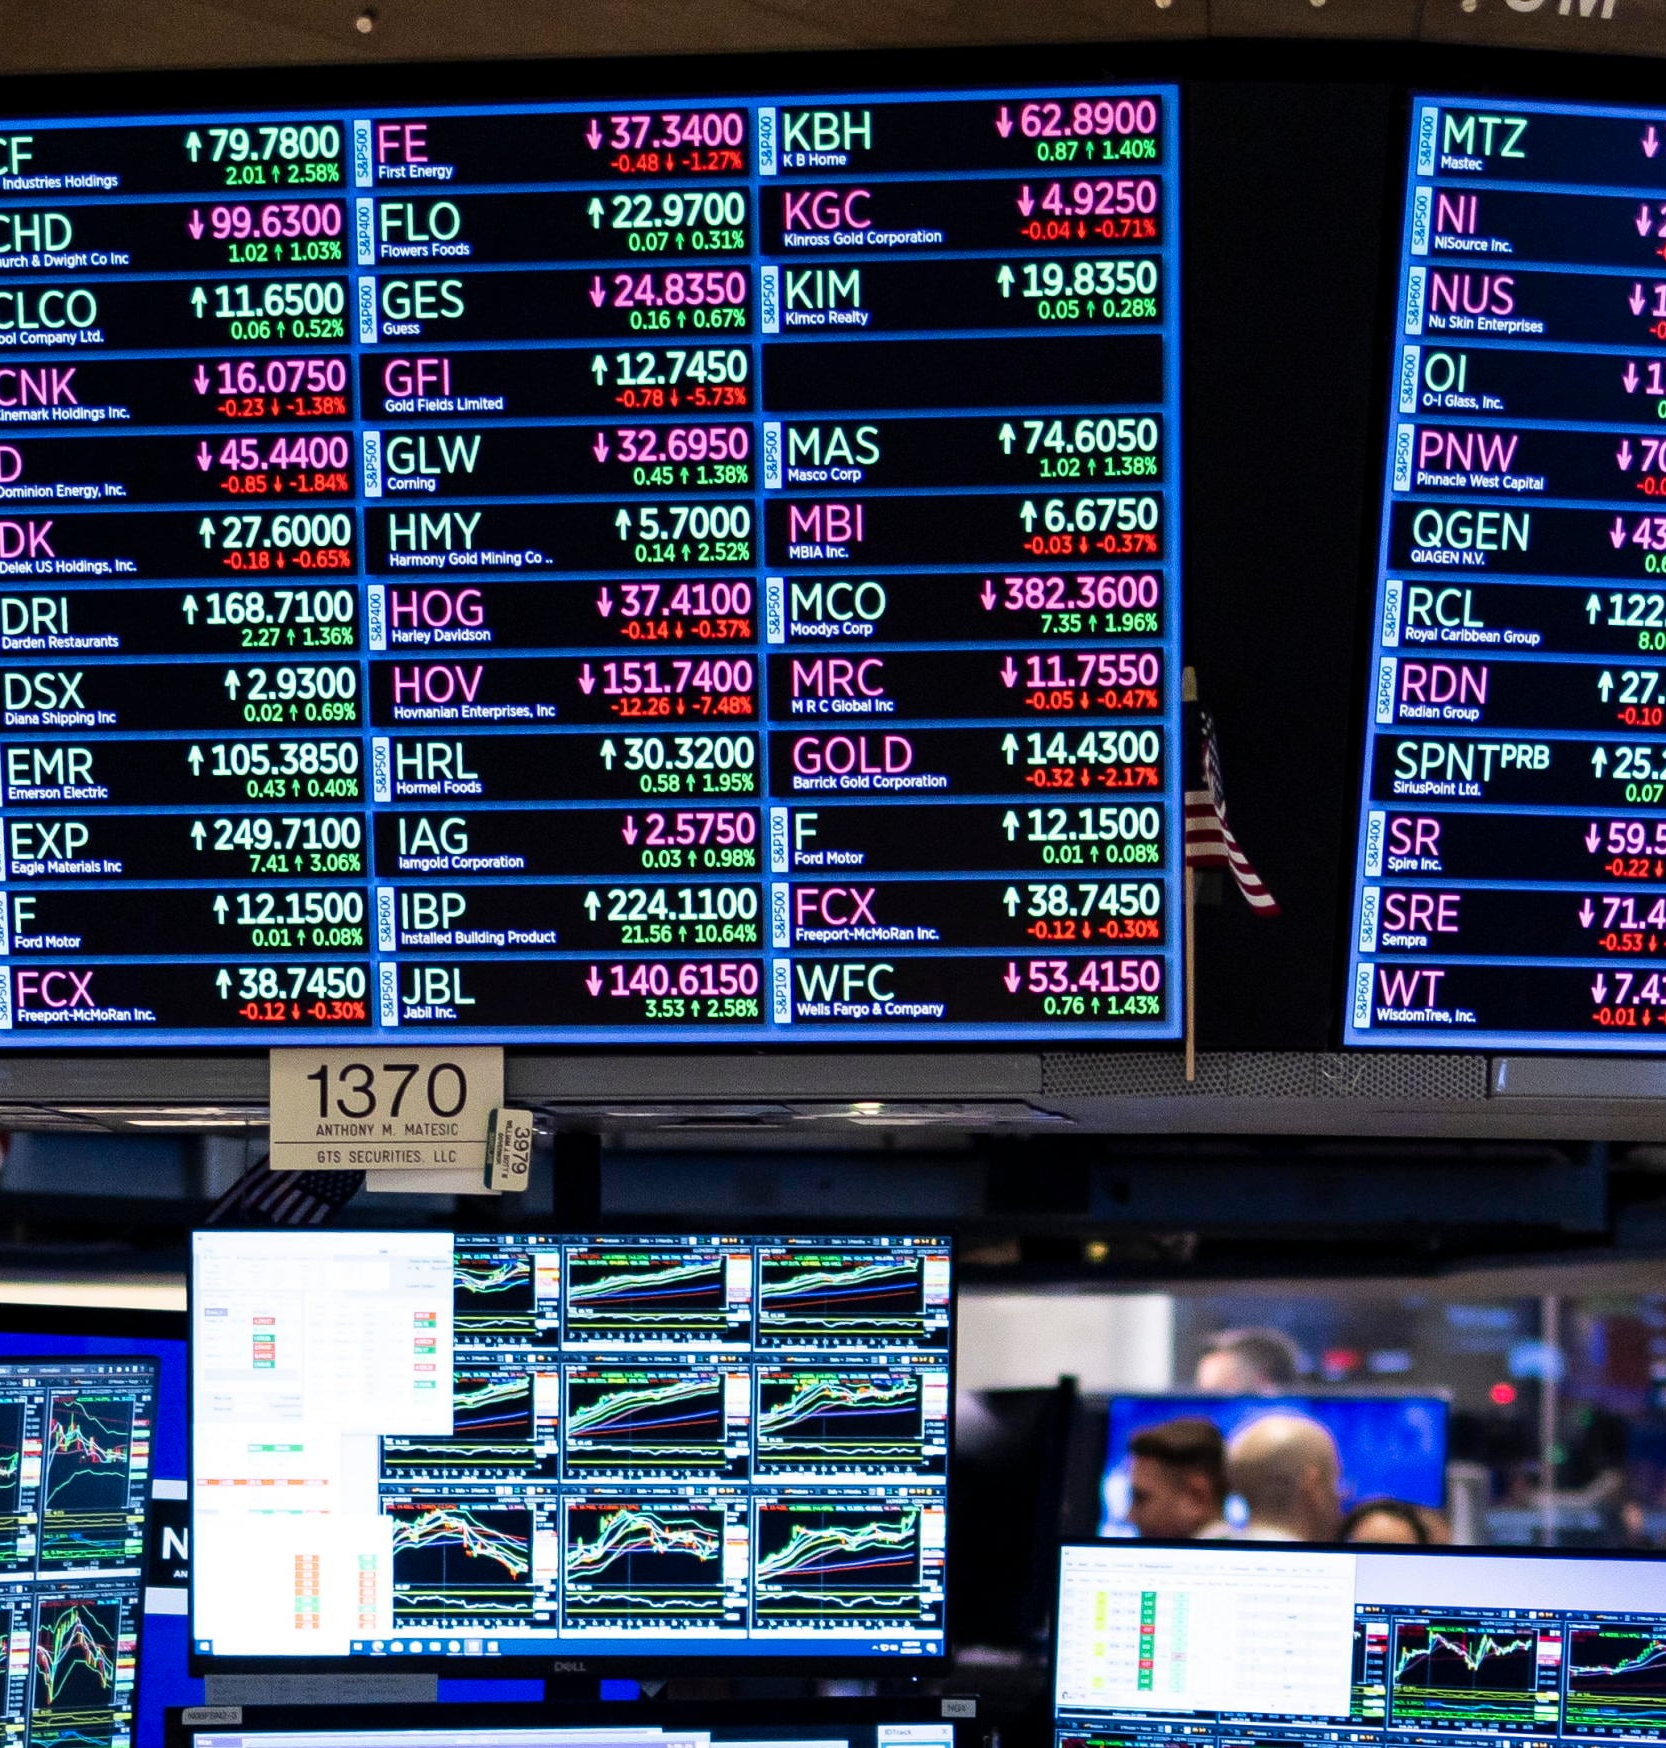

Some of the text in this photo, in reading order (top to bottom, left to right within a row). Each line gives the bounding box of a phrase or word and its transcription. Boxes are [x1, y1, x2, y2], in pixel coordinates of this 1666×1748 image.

[784, 111, 870, 151] KBH
[1021, 100, 1156, 137] 62.8900
[1444, 114, 1527, 158] MTZ
[1441, 155, 1482, 170] Mastec
[211, 204, 341, 239] 99.6300
[381, 202, 460, 241] FLO
[612, 192, 745, 228] 22.9700
[785, 190, 871, 230] KGC
[785, 231, 942, 246] Kinross Gold Corporation
[31, 255, 41, 268] &
[44, 254, 87, 268] Dwight
[90, 253, 108, 266] Co
[110, 252, 129, 265] Inc
[789, 426, 879, 466] MAS
[1024, 418, 1157, 454] 74.6050
[1420, 431, 1517, 472] PNW
[1413, 509, 1529, 551] QGEN
[206, 590, 353, 624] 168.7100
[392, 589, 483, 627] HOG
[792, 582, 885, 621] MCO
[1005, 575, 1158, 610] 382.3600
[1408, 587, 1483, 627] RCL
[1, 597, 68, 635] DRI
[392, 629, 490, 644] Harley Davidson
[394, 666, 483, 703] HOV
[603, 660, 752, 694] 151.7400
[793, 736, 912, 774] GOLD
[1027, 730, 1159, 764] 14.4300
[1384, 893, 1460, 932] SRE
[18, 971, 94, 1007] FCX
[239, 967, 365, 999] 38.7450
[796, 964, 894, 1001] WFC
[1029, 960, 1160, 992] 53.4150
[307, 1063, 467, 1118] 1370
[316, 1124, 458, 1136] ANTHONY M. MATESIC
[434, 1151, 456, 1163] LLC
[512, 1126, 530, 1175] 3979
